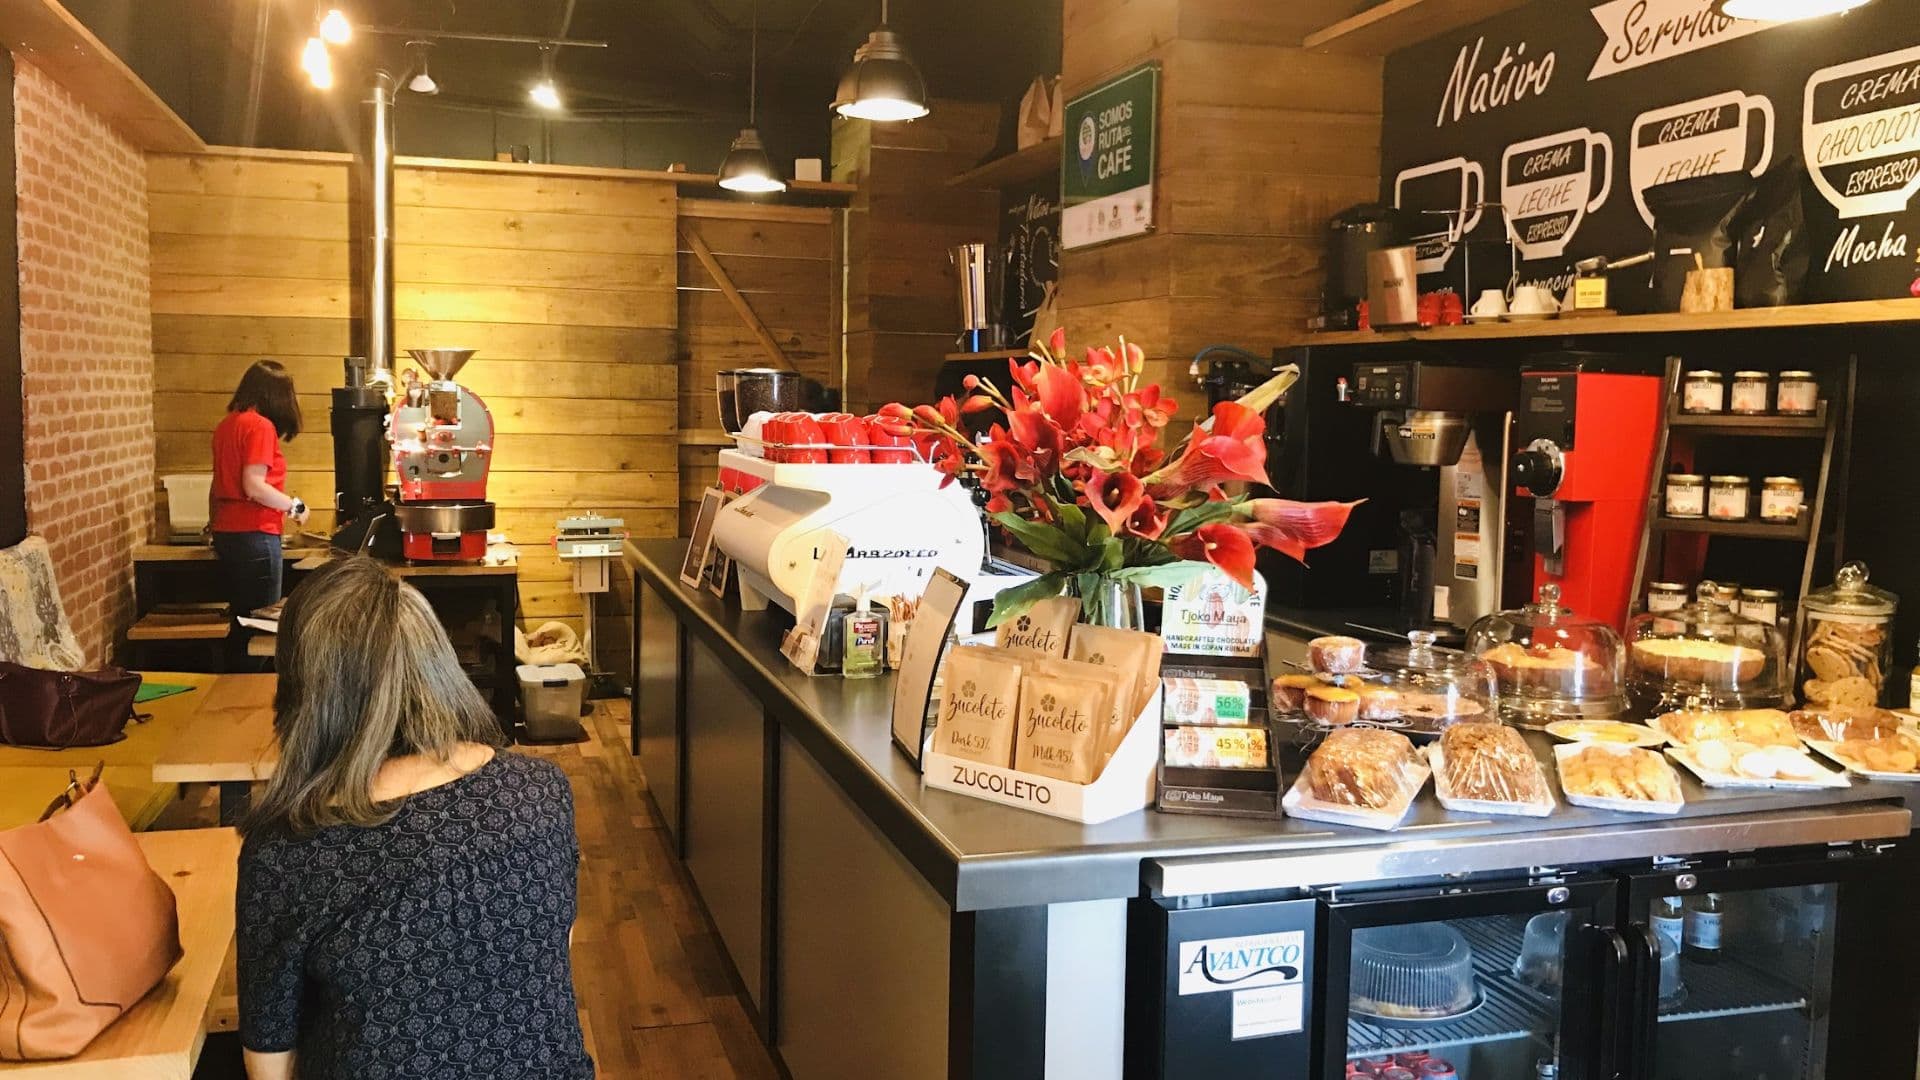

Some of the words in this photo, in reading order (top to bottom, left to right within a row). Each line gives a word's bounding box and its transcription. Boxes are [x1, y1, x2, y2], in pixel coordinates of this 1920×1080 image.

[1437, 36, 1554, 127] Nativo
[1841, 65, 1920, 109] CREMA
[1098, 100, 1133, 130] SOMOS
[1659, 107, 1720, 144] CREMA
[1098, 126, 1123, 151] RUTA
[1097, 139, 1132, 180] CAFÉ
[1523, 146, 1571, 177] CREMA
[1846, 157, 1918, 195] ESPRESSO
[1518, 179, 1576, 216] LECHE
[1527, 215, 1568, 243] ESPRESSO
[1824, 221, 1907, 272] Mocha
[1181, 609, 1211, 624] Tjoko
[1213, 611, 1247, 626] Maya
[1166, 634, 1216, 643] HANDCRAFTED
[1216, 636, 1256, 645] CHOCOLATE
[951, 730, 972, 748] Dark
[1032, 743, 1054, 761] Milk
[953, 766, 1051, 804] ZUCOLETO
